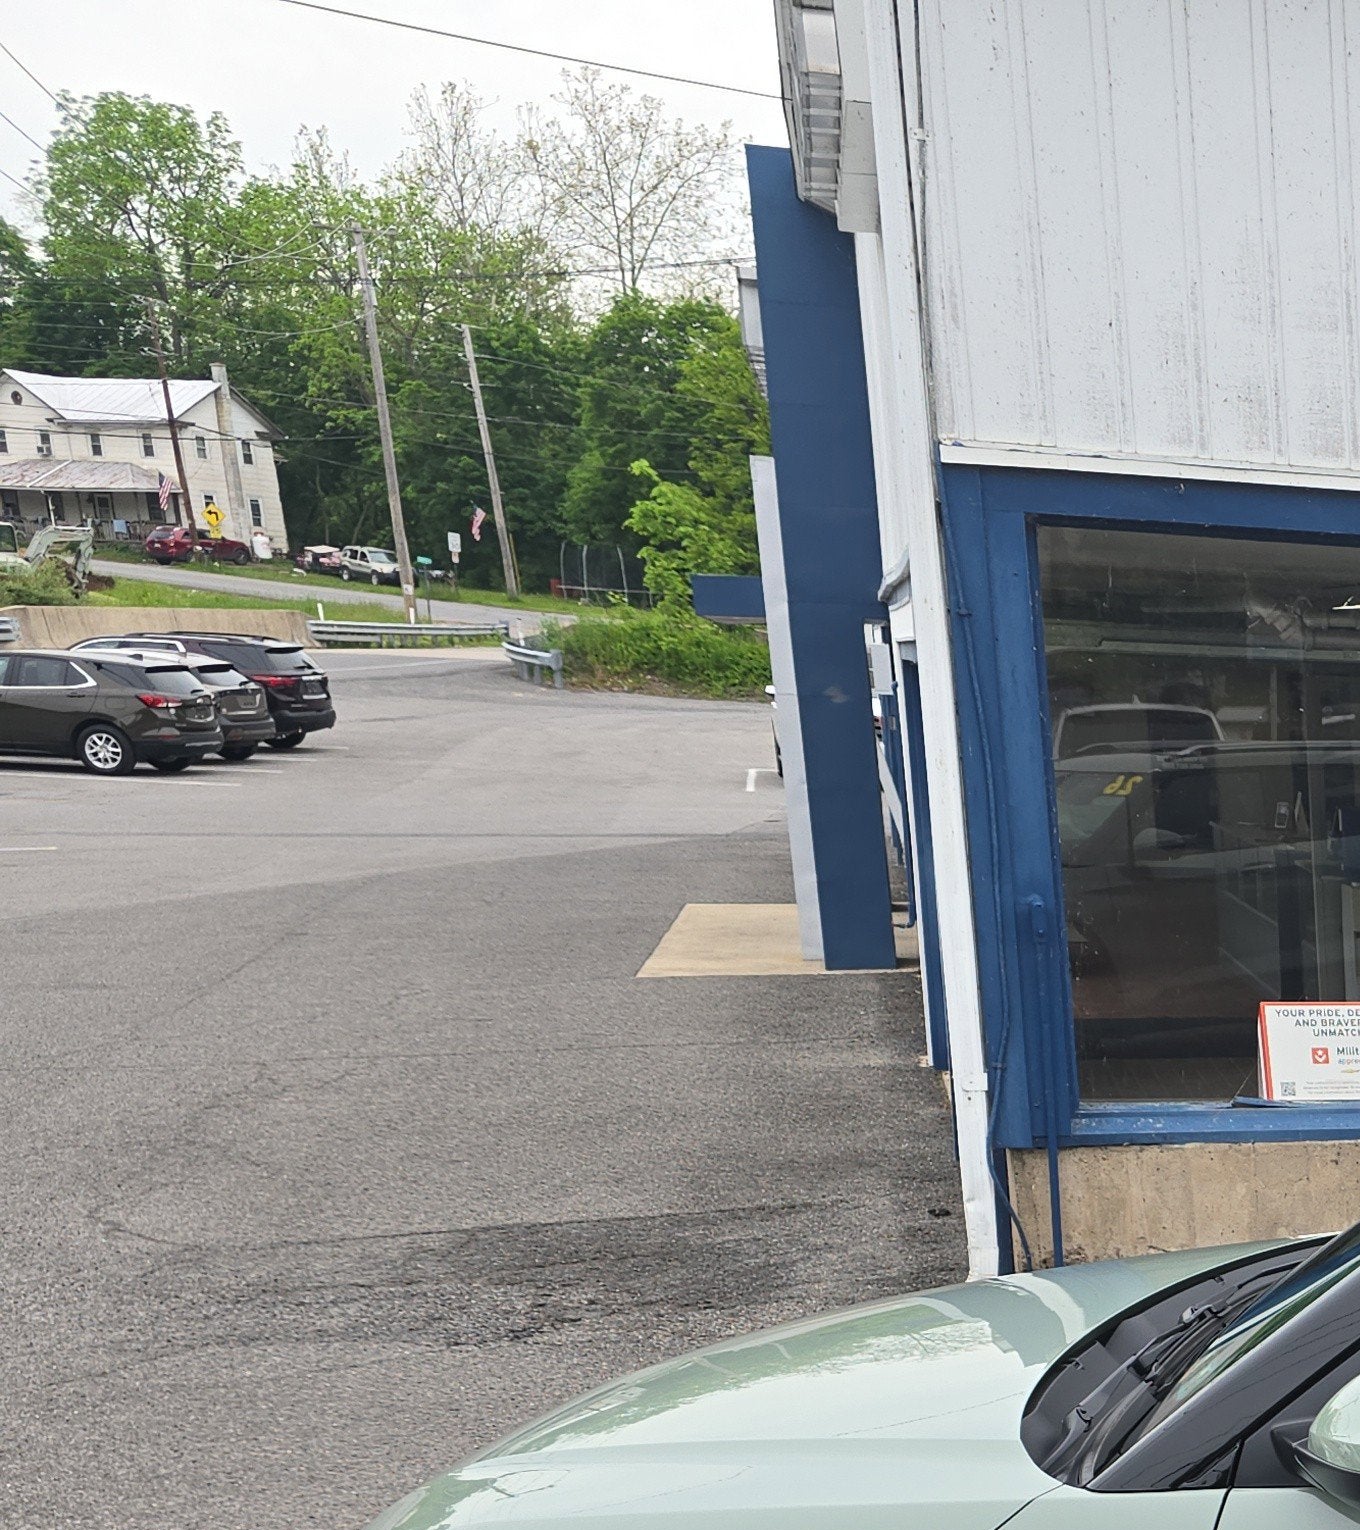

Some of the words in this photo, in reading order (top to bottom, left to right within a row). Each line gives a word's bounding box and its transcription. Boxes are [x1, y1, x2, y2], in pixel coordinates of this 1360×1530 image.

[1275, 1008, 1305, 1018] YOUR
[1308, 1008, 1345, 1018] PRIDE,
[1294, 1018, 1317, 1027] AND
